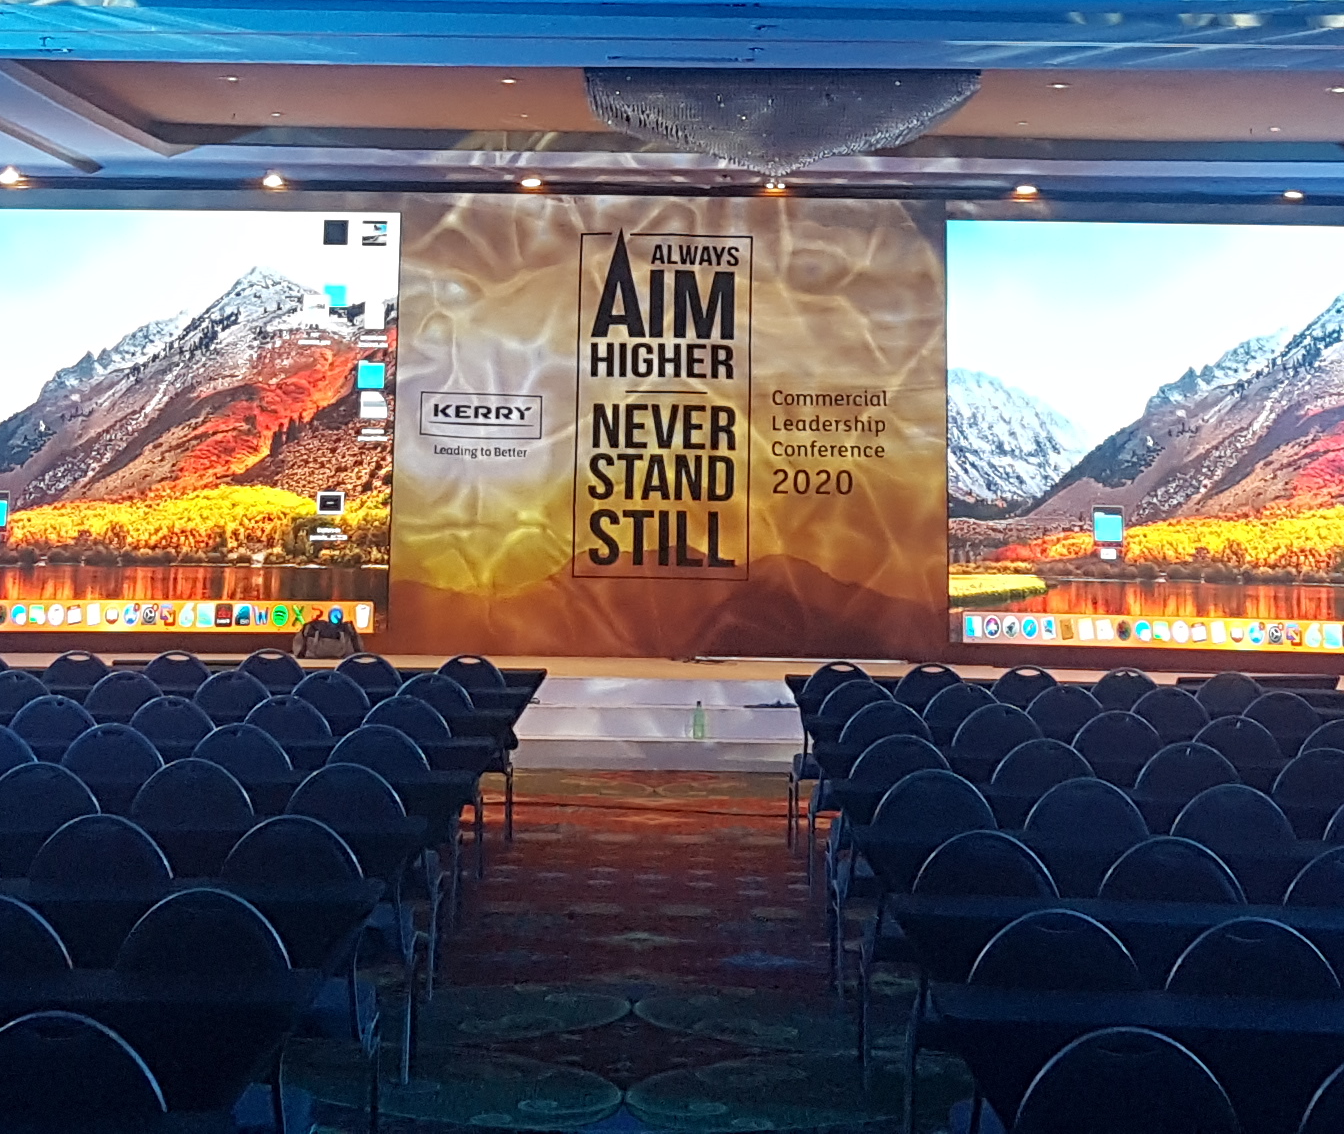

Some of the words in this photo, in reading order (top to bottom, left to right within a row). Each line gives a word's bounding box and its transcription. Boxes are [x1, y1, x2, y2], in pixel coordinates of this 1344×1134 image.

[650, 244, 740, 267] ALWAYS
[590, 227, 735, 341] AIM
[590, 342, 734, 380] HIGHER
[772, 389, 887, 407] Commercial
[433, 403, 533, 421] KERRY
[592, 403, 737, 451] NEVER
[772, 415, 886, 437] Leadership
[434, 444, 478, 459] Leading
[480, 447, 492, 457] to
[494, 447, 528, 458] Better
[771, 440, 886, 458] Conference
[587, 452, 736, 502] STAND
[772, 468, 854, 496] 2020
[588, 508, 737, 568] STILL
